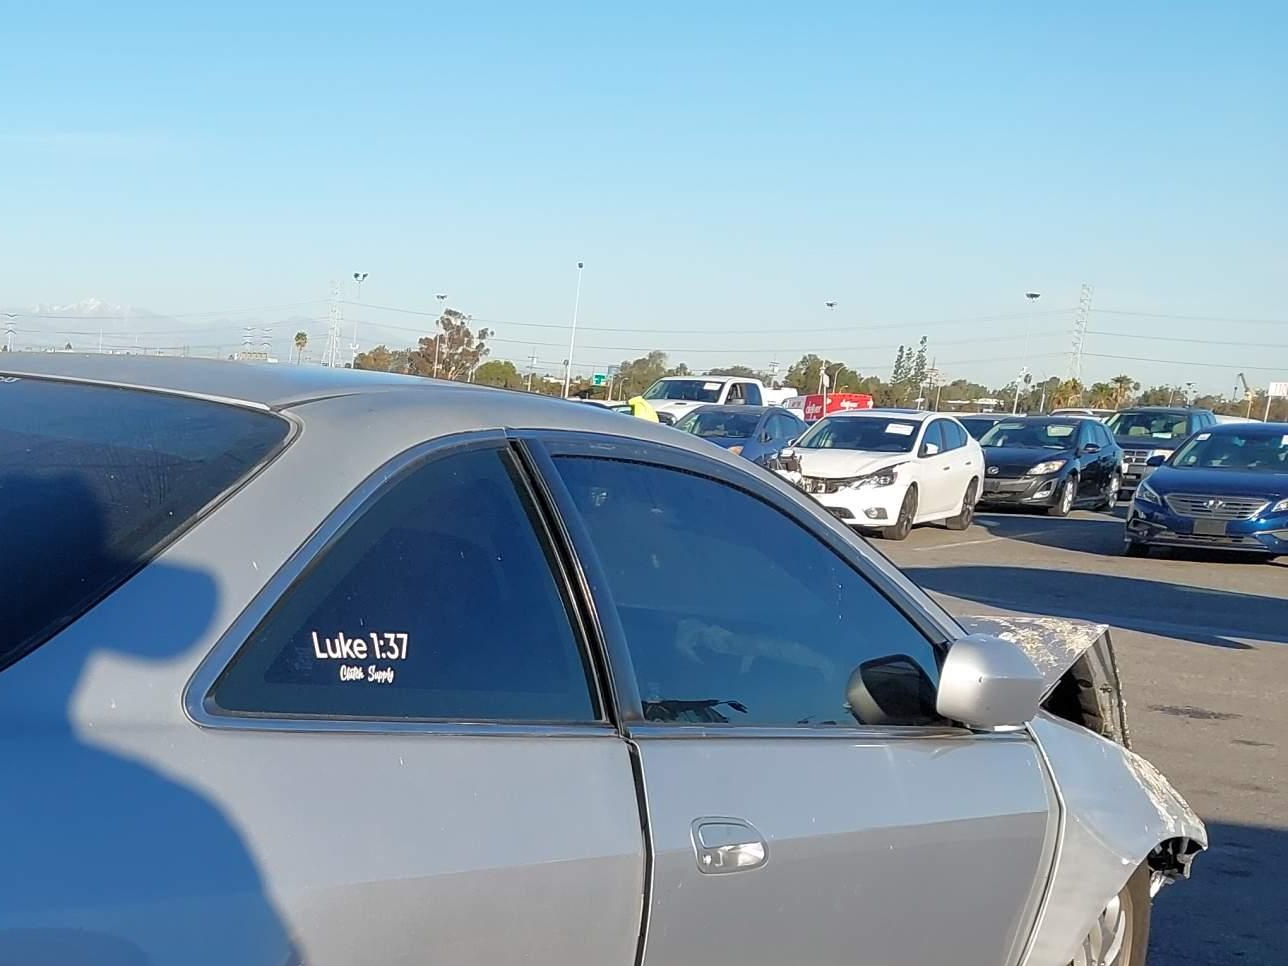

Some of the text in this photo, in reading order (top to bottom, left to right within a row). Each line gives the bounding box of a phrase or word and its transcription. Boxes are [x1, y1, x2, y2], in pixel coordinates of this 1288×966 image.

[311, 631, 409, 660] Luke 1:37
[367, 664, 395, 684] Supply
